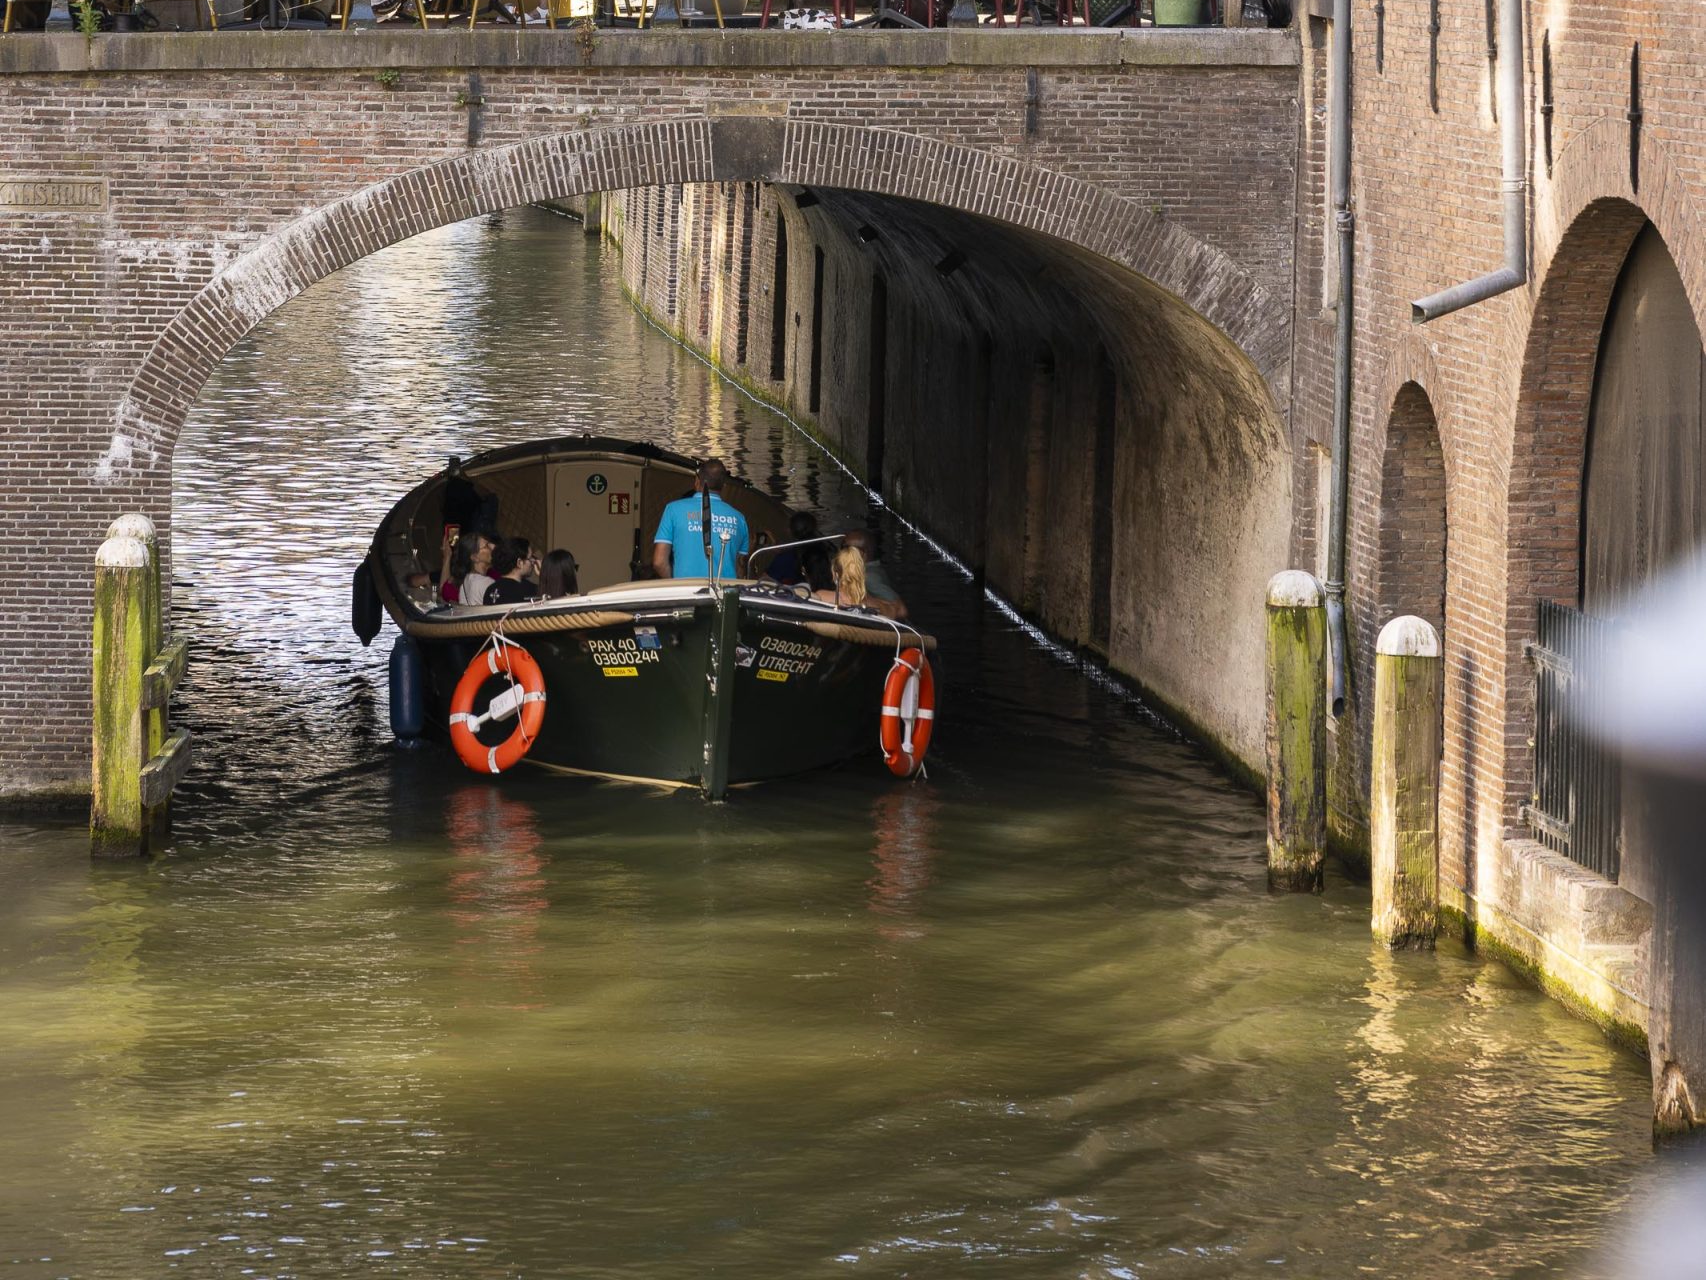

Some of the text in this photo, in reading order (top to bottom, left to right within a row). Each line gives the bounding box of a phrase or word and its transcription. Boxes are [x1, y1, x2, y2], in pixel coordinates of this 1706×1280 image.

[0, 183, 101, 205] ALISBRUG
[588, 638, 637, 653] PAX 40
[761, 636, 822, 659] 03800244
[593, 650, 660, 666] 03800244
[758, 654, 814, 674] UTRECHT
